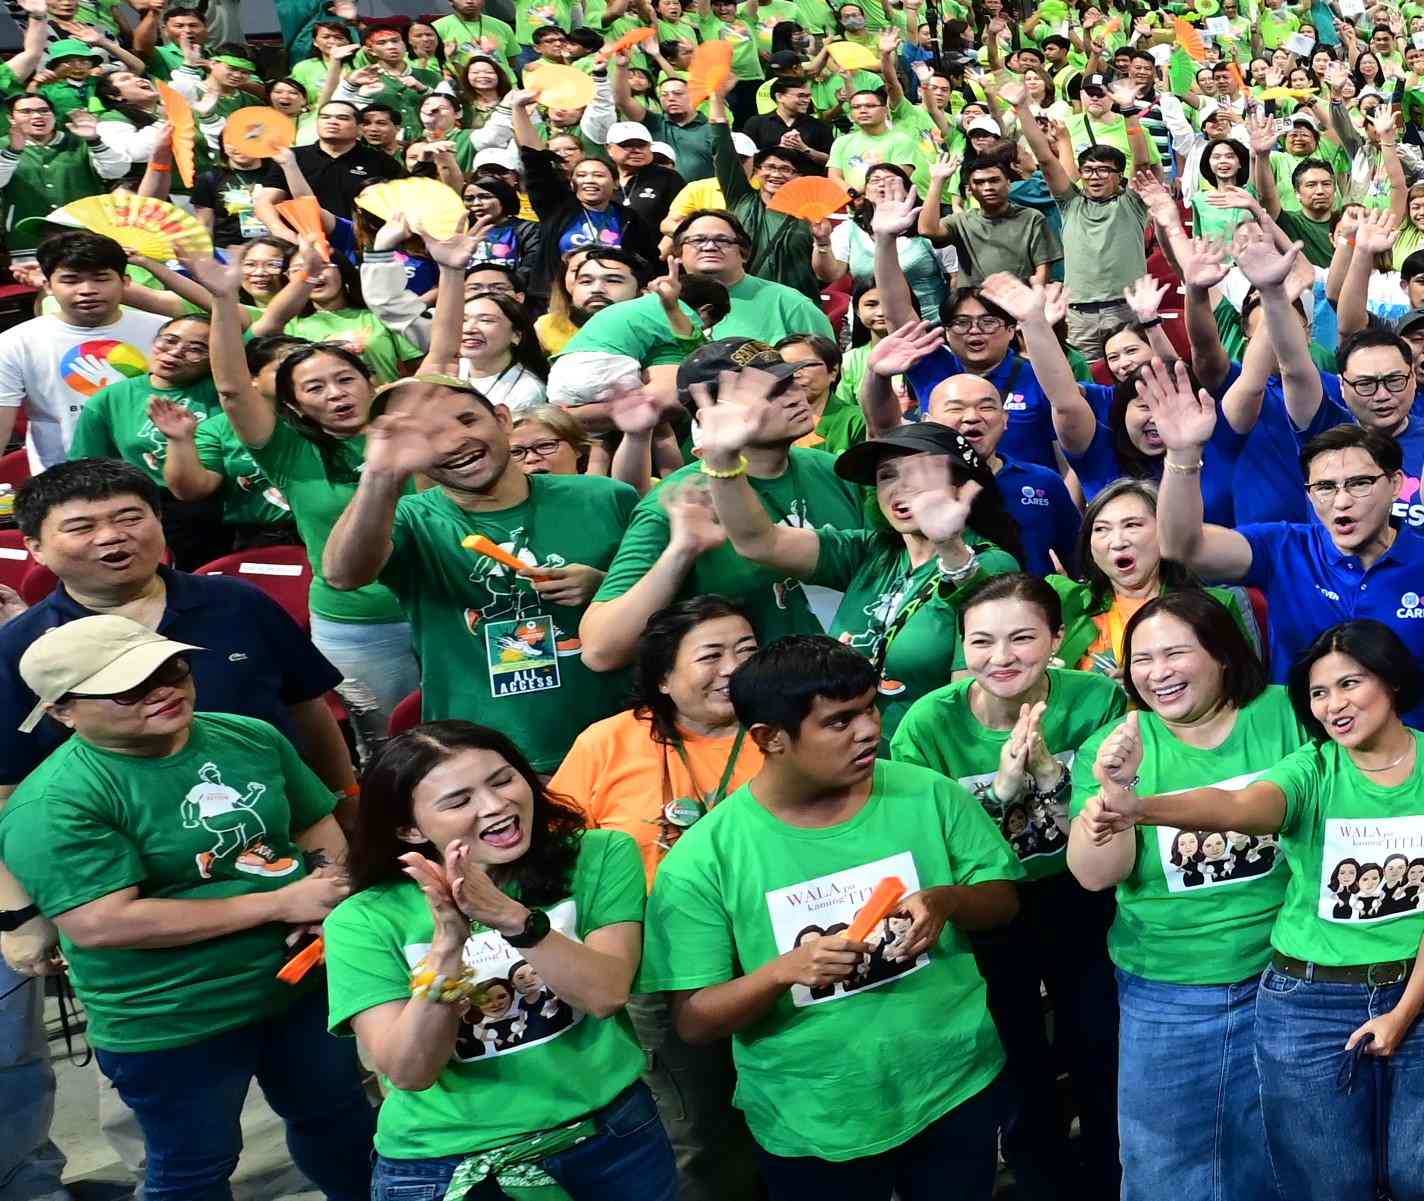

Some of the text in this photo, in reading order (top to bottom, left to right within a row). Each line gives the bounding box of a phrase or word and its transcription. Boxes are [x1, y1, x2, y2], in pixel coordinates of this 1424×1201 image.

[1003, 403, 1026, 411] ARES
[1021, 497, 1049, 507] CARES
[499, 674, 556, 694] ACCESS
[513, 670, 540, 685] ALL
[1338, 824, 1384, 838] WALA
[787, 882, 839, 908] WALA
[807, 897, 847, 912] kaming
